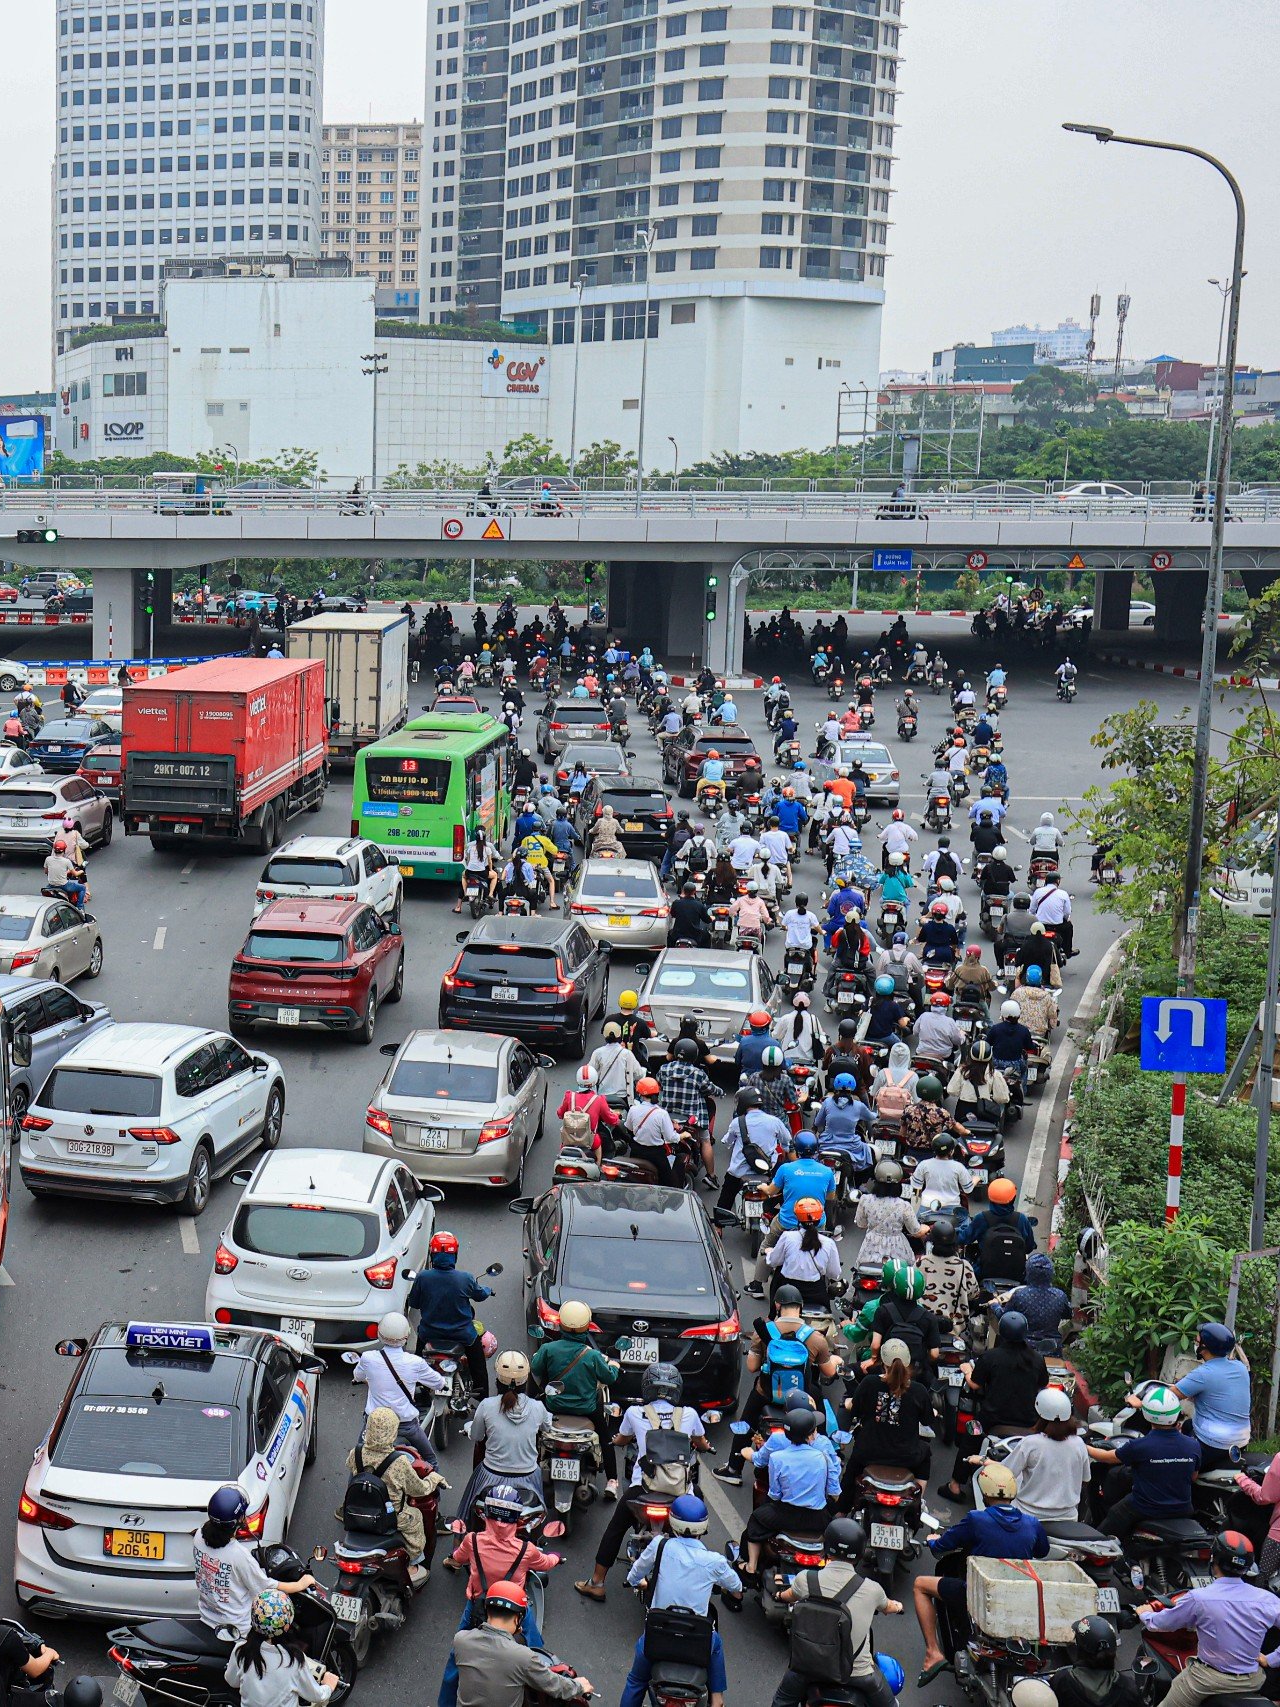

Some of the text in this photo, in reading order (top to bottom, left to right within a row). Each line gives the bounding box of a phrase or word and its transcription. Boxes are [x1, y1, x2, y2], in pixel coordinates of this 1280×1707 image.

[506, 360, 539, 382] CGV
[506, 383, 540, 393] CINEMAS
[104, 421, 144, 436] LOOP
[138, 707, 168, 716] viettel
[153, 763, 210, 776] 29KT-007.12
[402, 760, 416, 771] 13
[527, 839, 541, 850] be
[426, 1130, 442, 1139] 22A
[288, 1319, 306, 1331] 30F
[168, 1328, 188, 1336] MINH
[621, 1349, 658, 1363] 788.49
[555, 1459, 576, 1469] 29-V7
[552, 1468, 578, 1480] 486.85
[127, 1531, 150, 1545] 30G
[872, 1536, 901, 1549] 479.65
[117, 1543, 159, 1558] 206.11
[333, 1605, 358, 1621] 24.79
